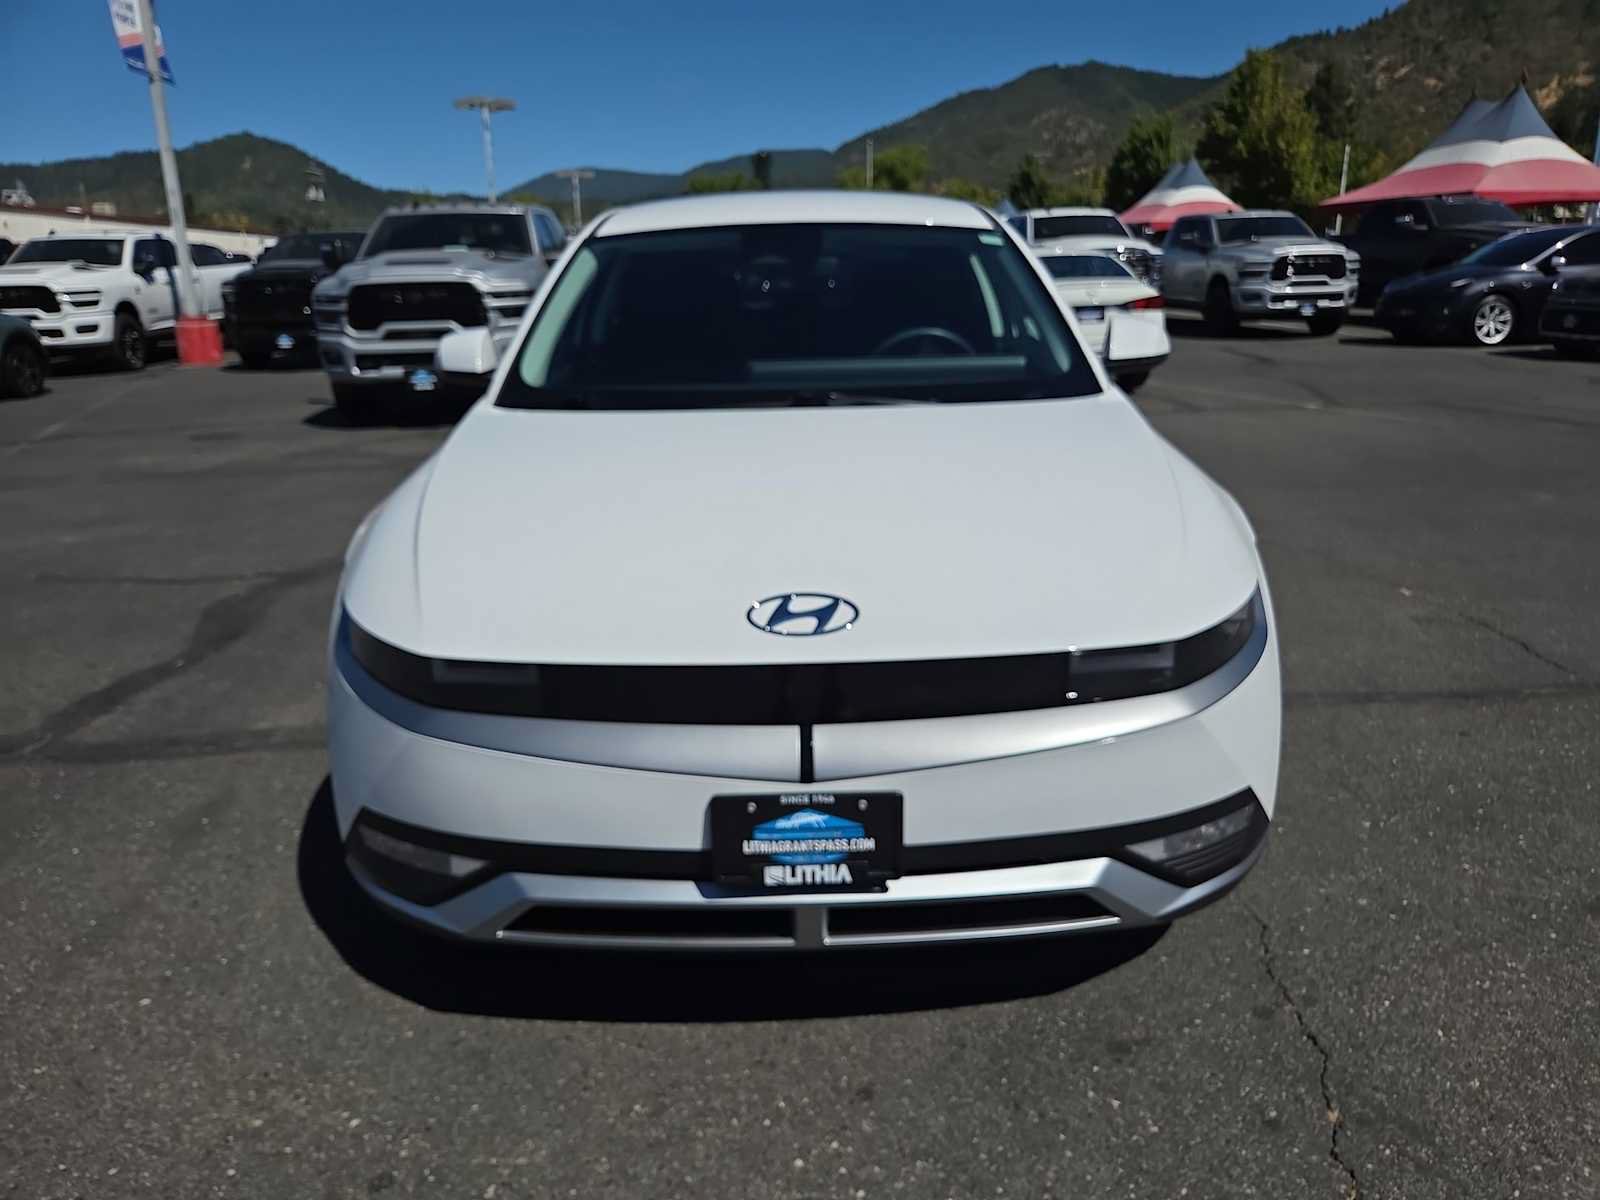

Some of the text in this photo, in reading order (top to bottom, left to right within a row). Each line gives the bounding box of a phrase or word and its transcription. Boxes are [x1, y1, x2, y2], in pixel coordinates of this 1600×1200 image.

[780, 794, 809, 805] SINCE
[742, 838, 875, 855] LITHIAGRANTSPASS.COM
[785, 864, 853, 885] LITHIA
